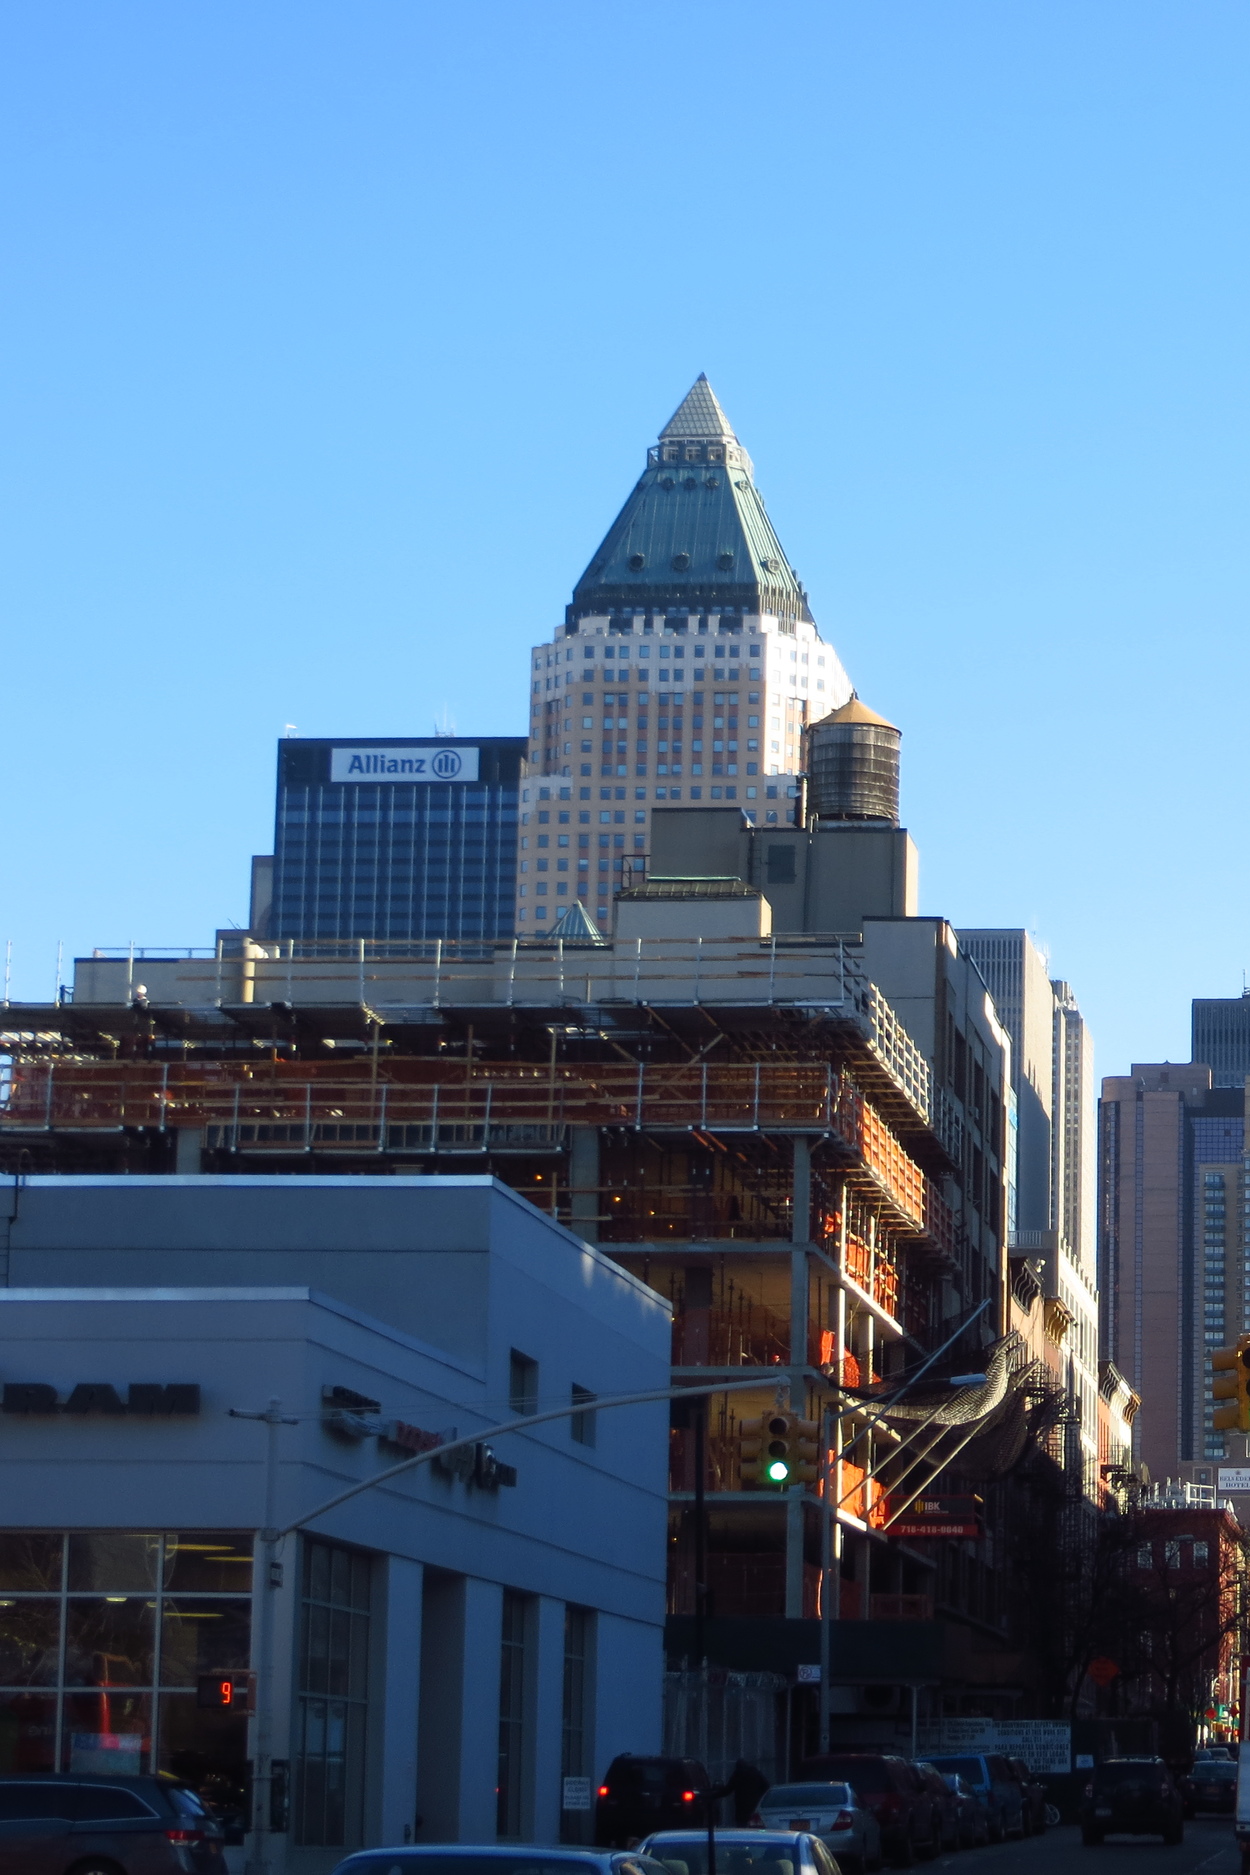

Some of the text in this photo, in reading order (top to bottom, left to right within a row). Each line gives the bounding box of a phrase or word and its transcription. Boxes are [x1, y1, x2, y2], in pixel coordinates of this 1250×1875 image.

[348, 754, 426, 774] Allianz
[2, 1383, 201, 1415] RAM
[925, 1502, 940, 1510] IBK
[221, 1682, 232, 1704] 9
